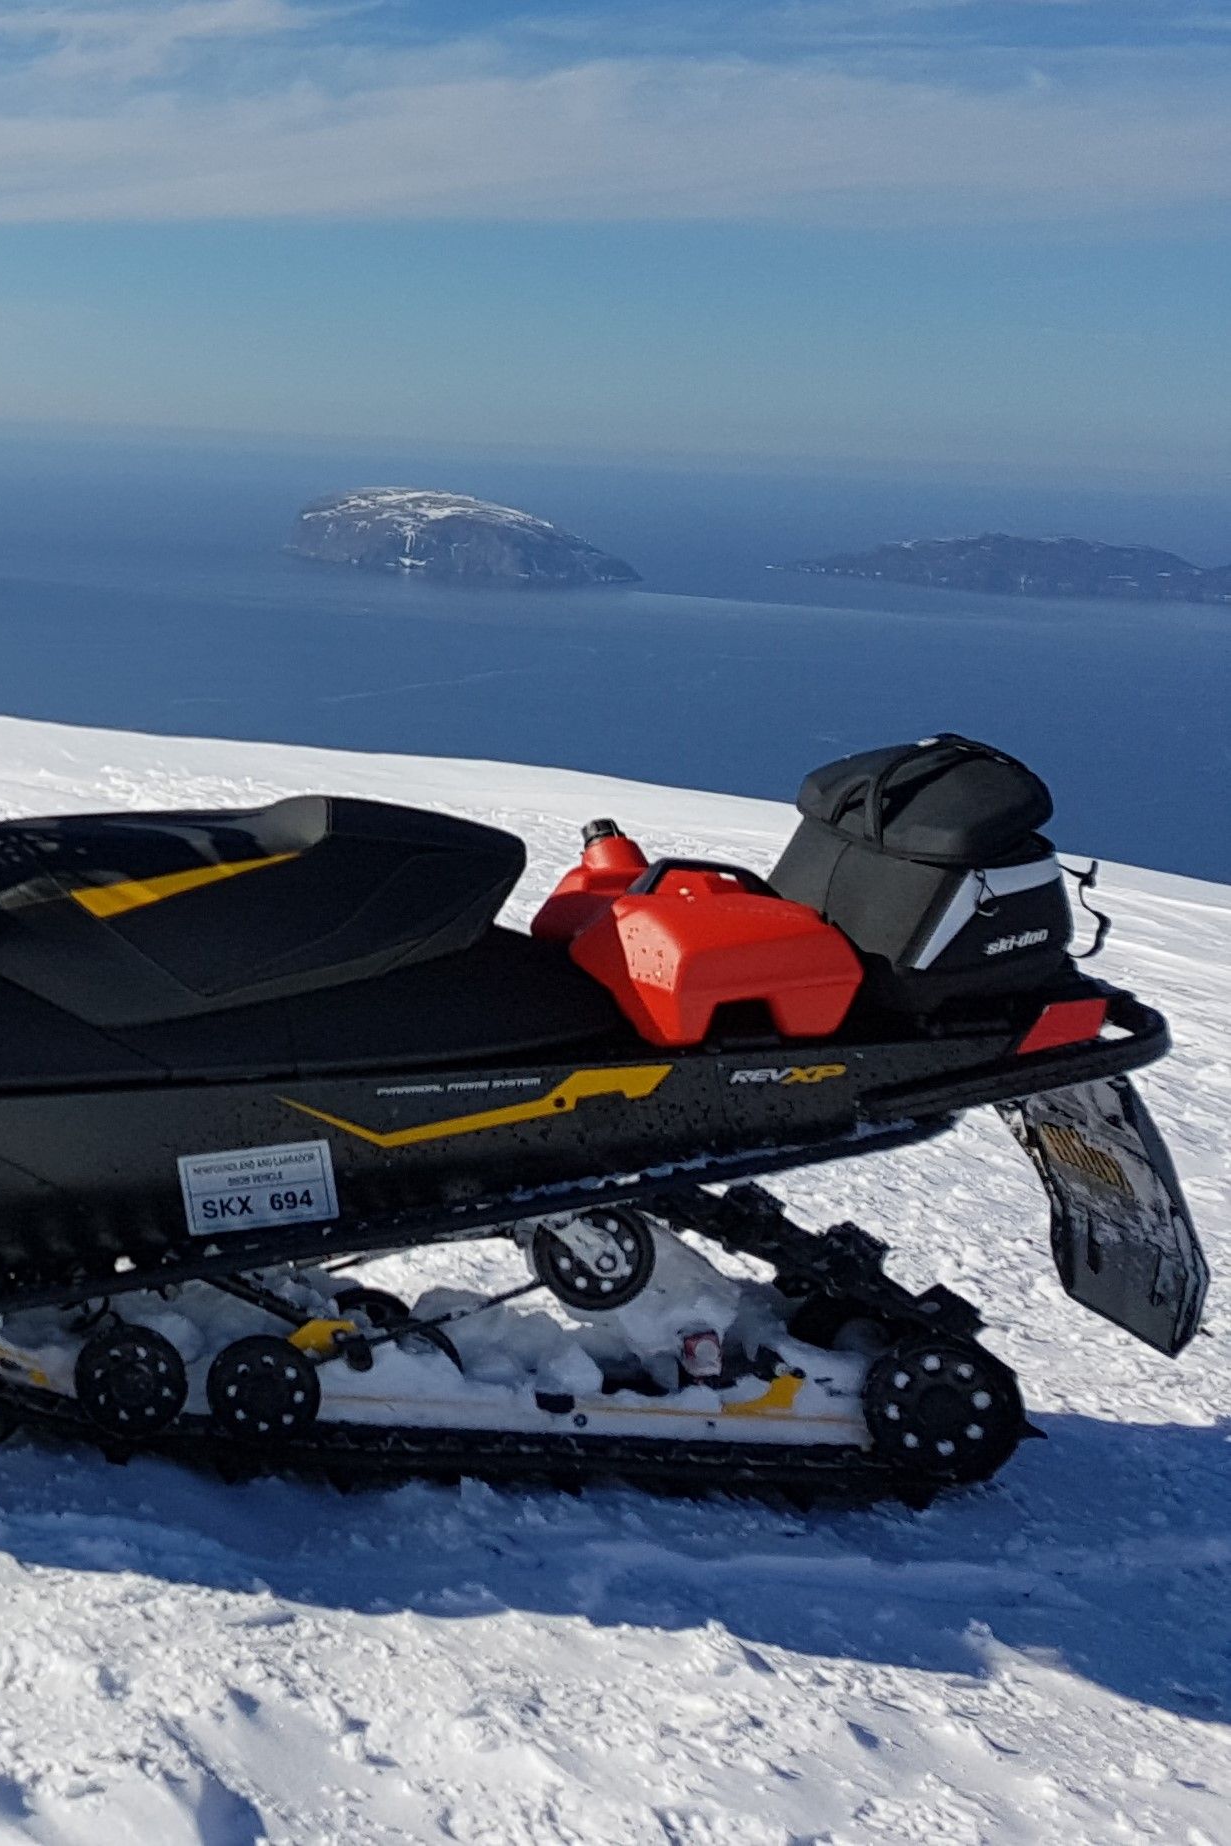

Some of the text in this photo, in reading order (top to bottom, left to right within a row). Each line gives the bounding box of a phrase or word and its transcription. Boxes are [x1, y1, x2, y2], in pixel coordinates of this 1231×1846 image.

[983, 928, 1049, 956] ski-doo
[202, 1189, 314, 1219] SKX 694
